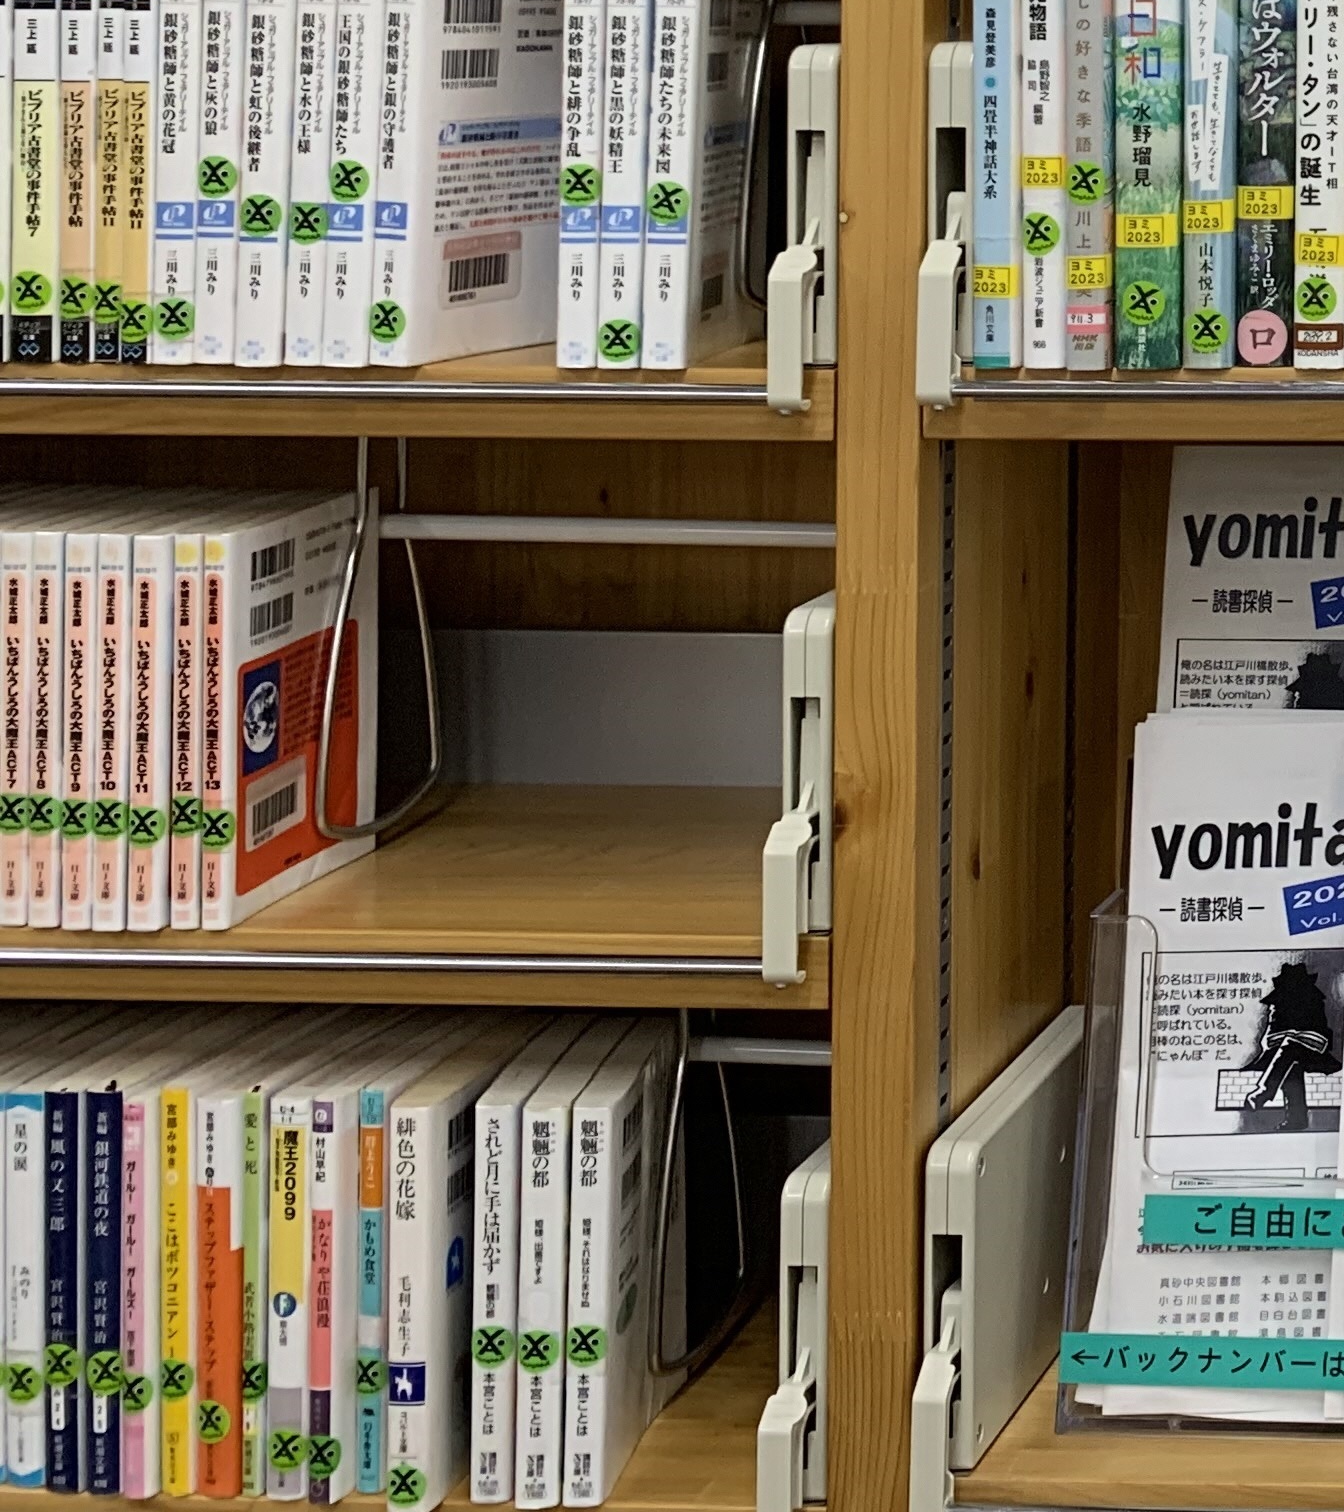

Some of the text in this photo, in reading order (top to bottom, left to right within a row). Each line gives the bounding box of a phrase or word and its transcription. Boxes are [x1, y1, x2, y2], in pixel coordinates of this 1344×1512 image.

[204, 11, 222, 136] 銀砂糖師と灰の狼
[248, 14, 267, 172] 銀砂糖師と虹の後継者
[336, 15, 353, 155] 王国の銀砂糖師たち
[382, 12, 400, 170] 銀砂糖師と銀の守護者
[566, 15, 584, 158] 銀砂糖師と緋の争乱
[608, 15, 626, 174] 銀砂糖師と黒の妖精王
[656, 15, 678, 176] 銀砂糖師たちの未来図
[68, 90, 84, 228] ビブリア古書堂の事件手帖
[984, 95, 998, 200] 四畳半神話大系
[1026, 172, 1058, 184] 2023
[1027, 160, 1047, 170] ヨミ
[1132, 103, 1152, 188] 水野瑠見
[1186, 218, 1220, 228] 2023
[1187, 205, 1208, 216] ヨミ
[1245, 204, 1278, 214] 2023
[1246, 191, 1267, 201] ヨミ
[571, 254, 584, 302] 三川みり
[1199, 242, 1214, 307] 山本悦子
[1260, 224, 1279, 309] エミリー・ロッダ
[1212, 590, 1274, 614] 読書探偵
[244, 1114, 258, 1176] 愛と死
[282, 1130, 299, 1222] 魔王2099
[396, 1116, 416, 1222] 緋色の花嫁
[363, 1220, 377, 1286] かもめ食堂
[482, 1372, 495, 1434] 本宮ことは
